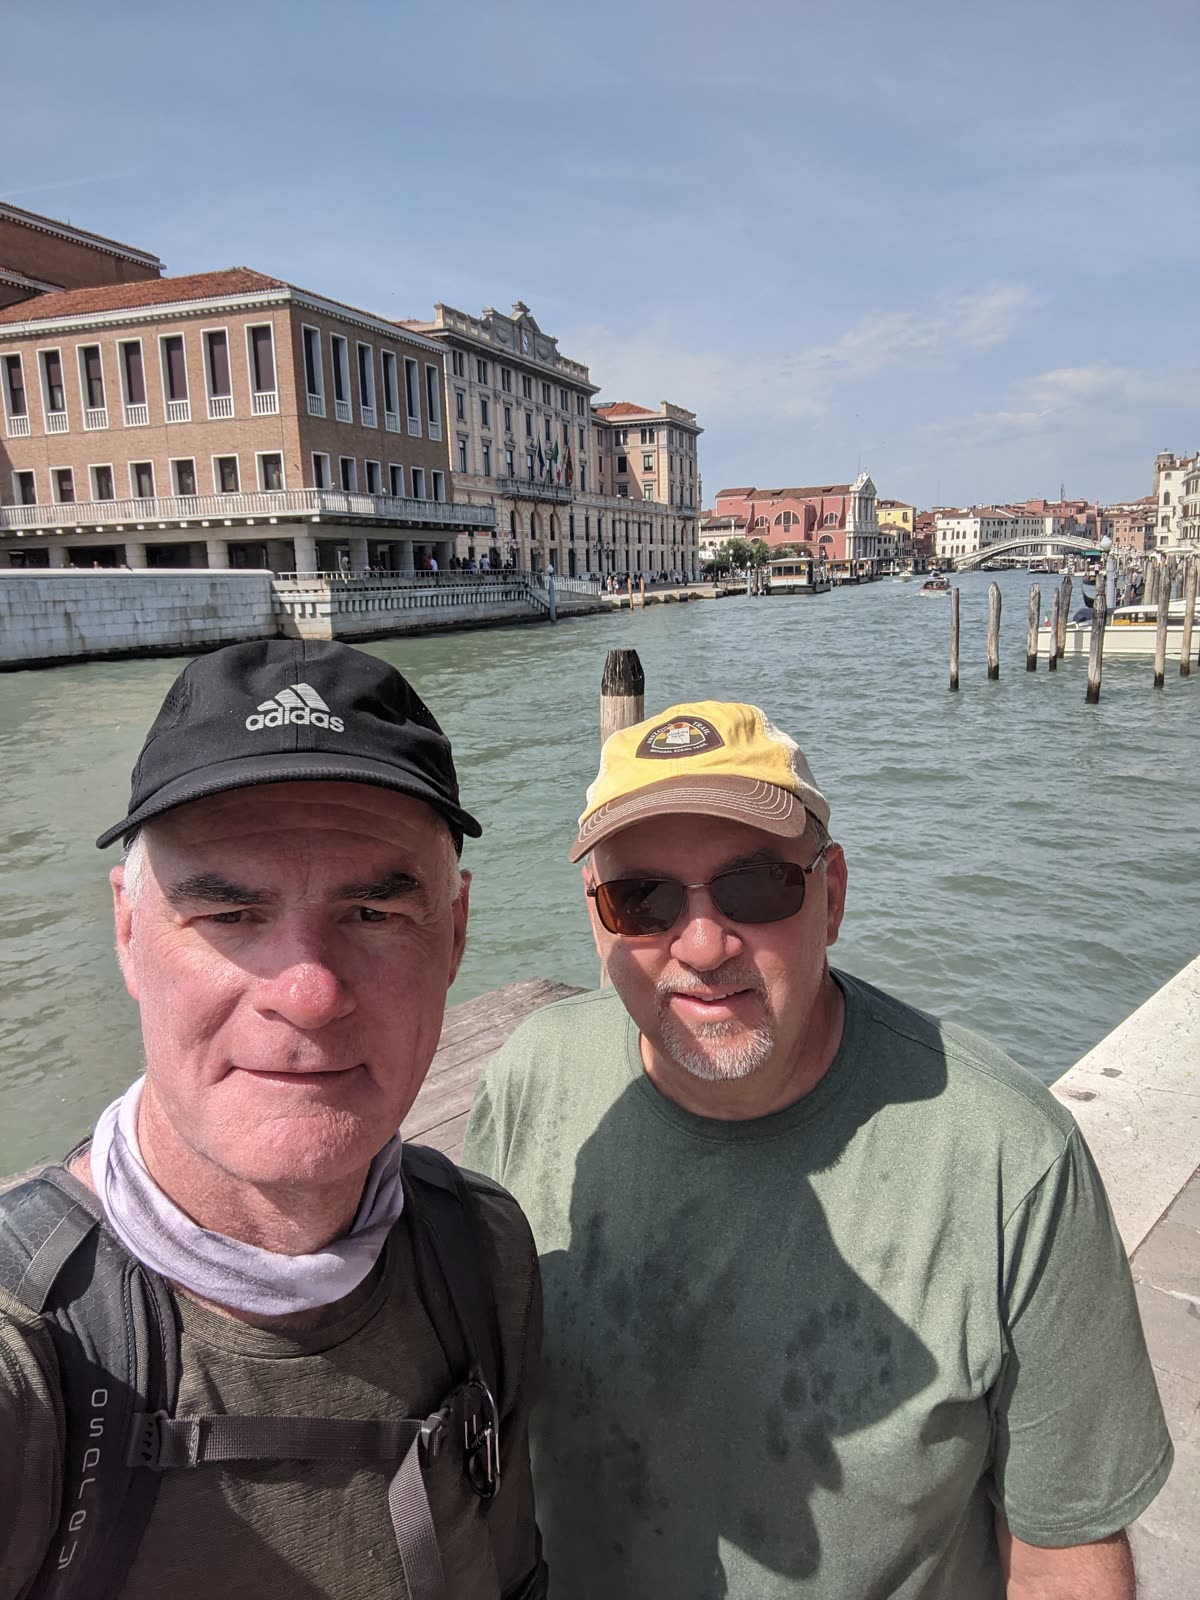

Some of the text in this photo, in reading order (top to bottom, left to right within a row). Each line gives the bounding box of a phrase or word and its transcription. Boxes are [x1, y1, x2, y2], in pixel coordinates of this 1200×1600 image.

[245, 706, 345, 732] adidas
[692, 721, 710, 736] TRAIL
[57, 1388, 108, 1570] osprey
